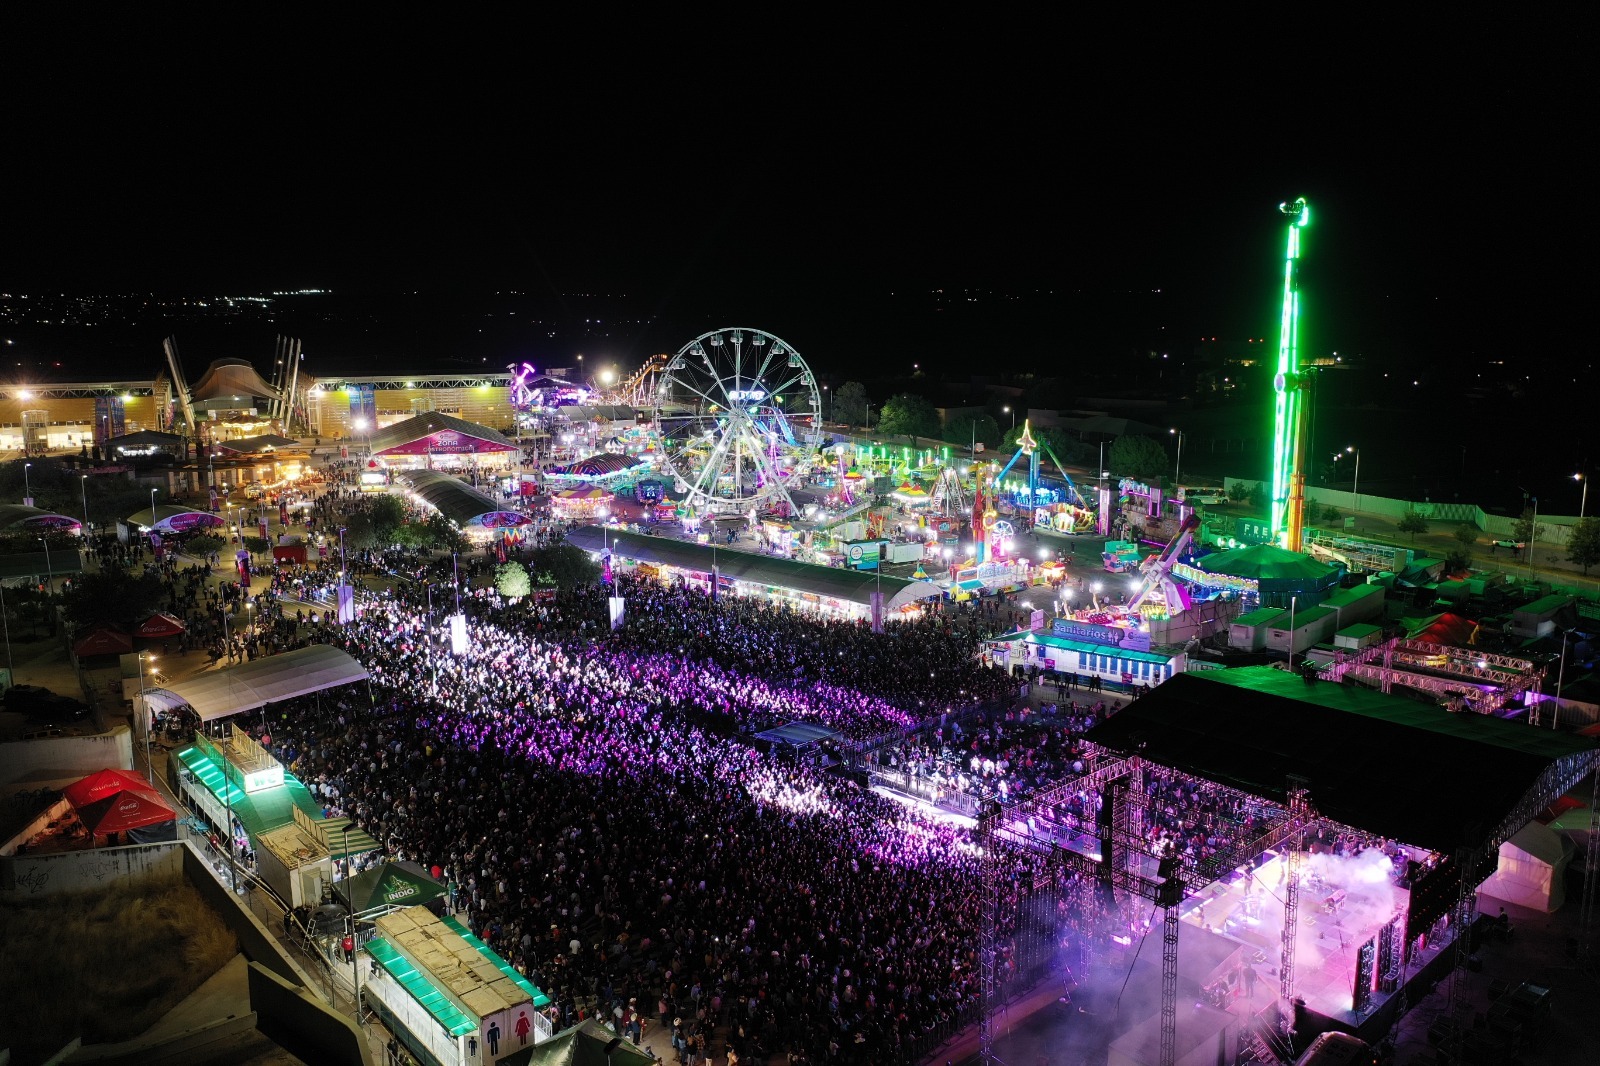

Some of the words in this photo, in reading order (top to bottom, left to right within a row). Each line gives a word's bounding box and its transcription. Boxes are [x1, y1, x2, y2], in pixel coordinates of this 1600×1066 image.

[1054, 622, 1106, 639] Sanitarios
[253, 773, 277, 787] WC
[388, 888, 414, 900] INDIO
